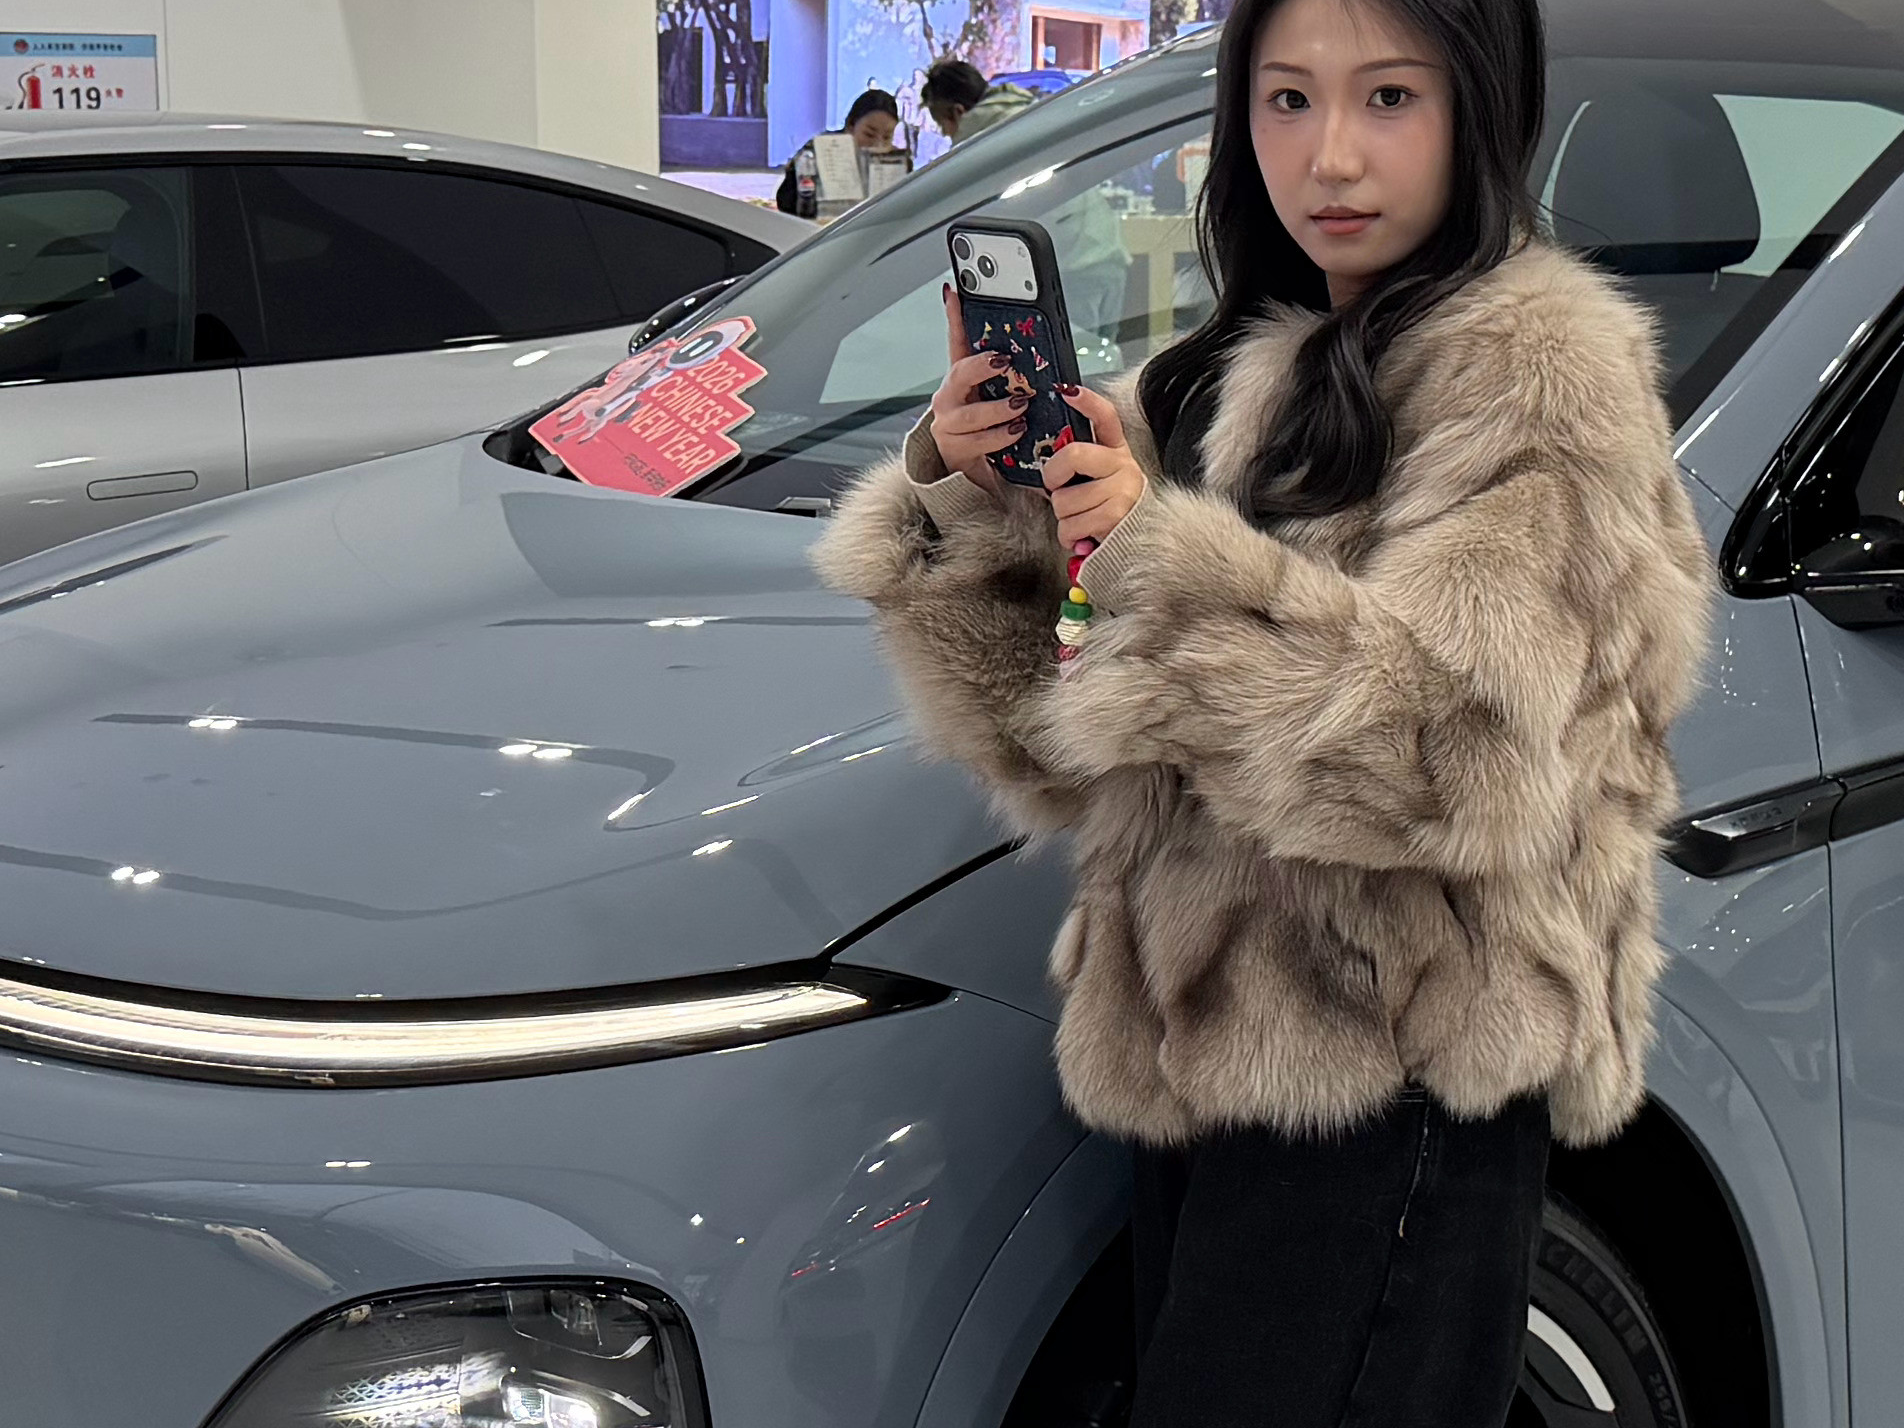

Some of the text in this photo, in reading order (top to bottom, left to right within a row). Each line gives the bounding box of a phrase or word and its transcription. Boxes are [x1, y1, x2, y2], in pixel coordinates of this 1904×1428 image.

[52, 64, 95, 78] 消火栓
[53, 87, 101, 109] 119
[687, 356, 745, 394] 2026
[651, 376, 733, 434] CHINESE
[628, 402, 676, 442] NEW
[657, 424, 715, 474] YEAR
[1546, 1240, 1648, 1356] CHELIN
